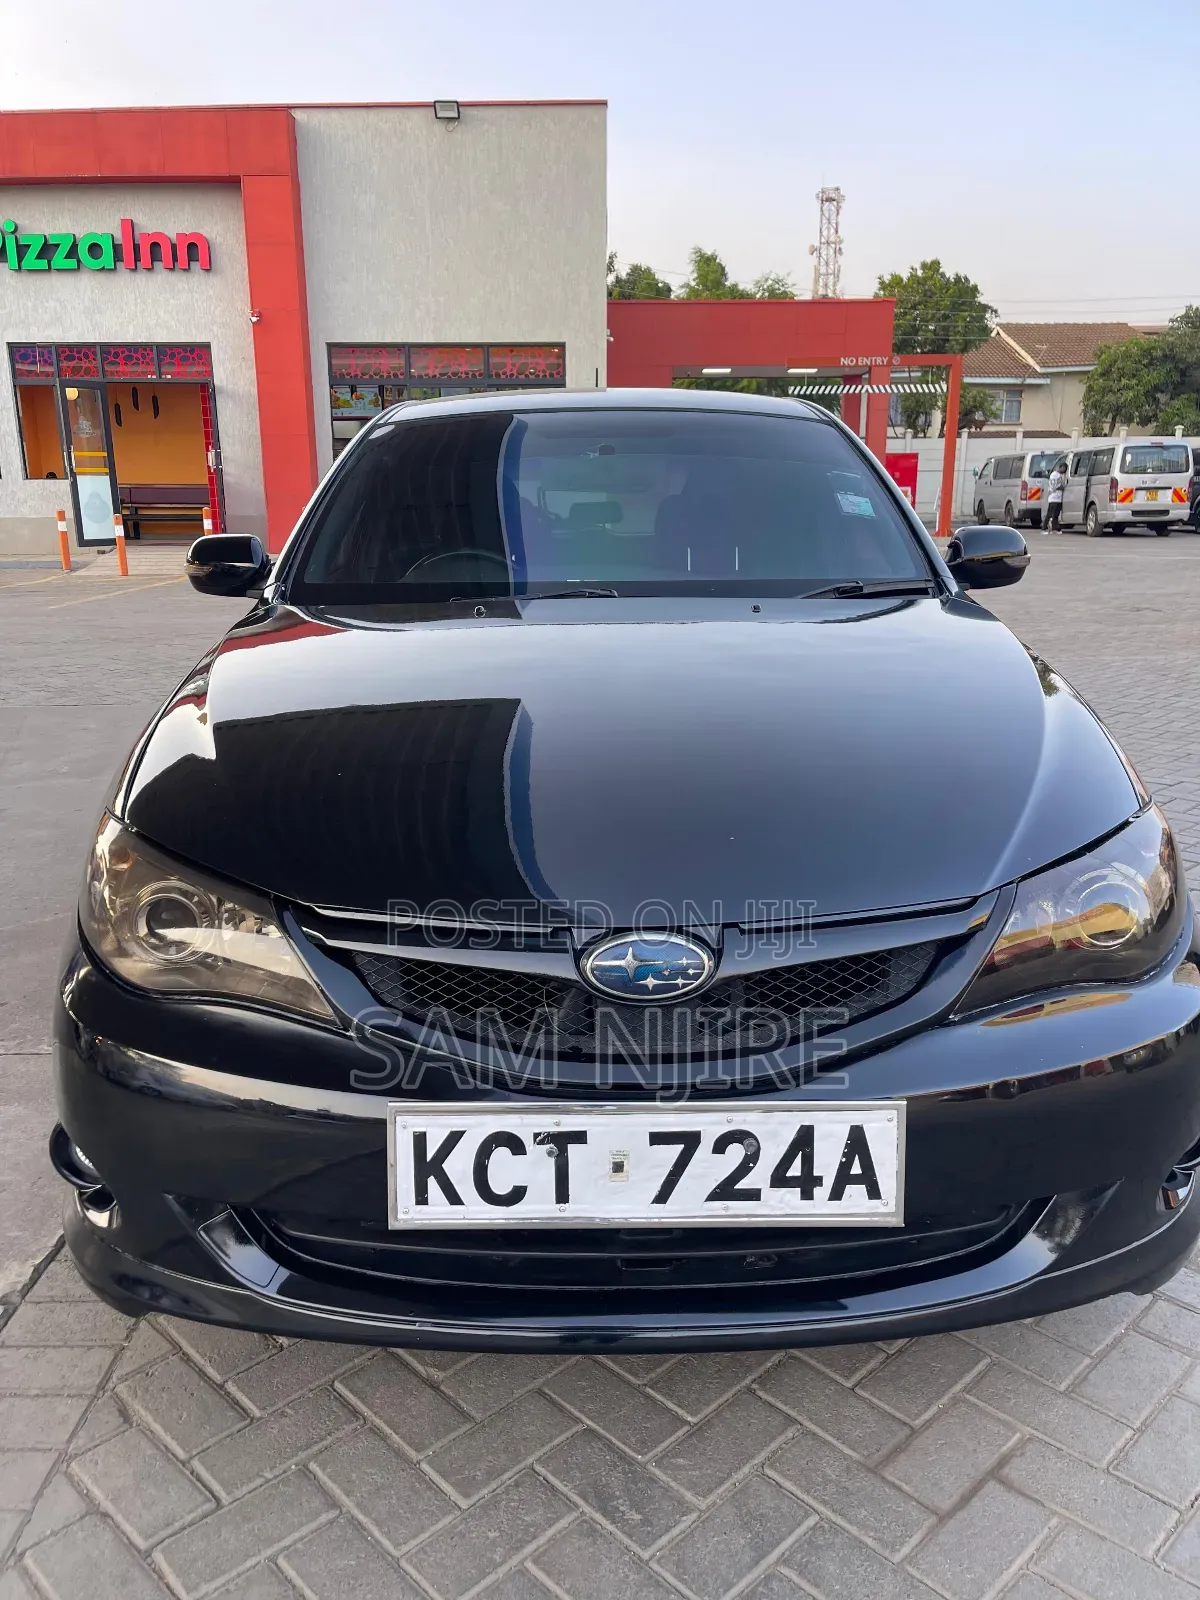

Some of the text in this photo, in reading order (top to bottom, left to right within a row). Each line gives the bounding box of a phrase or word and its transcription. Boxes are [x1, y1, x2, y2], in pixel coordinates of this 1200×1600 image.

[840, 356, 889, 366] NO ENTRY
[412, 1124, 884, 1207] KCT 724A
